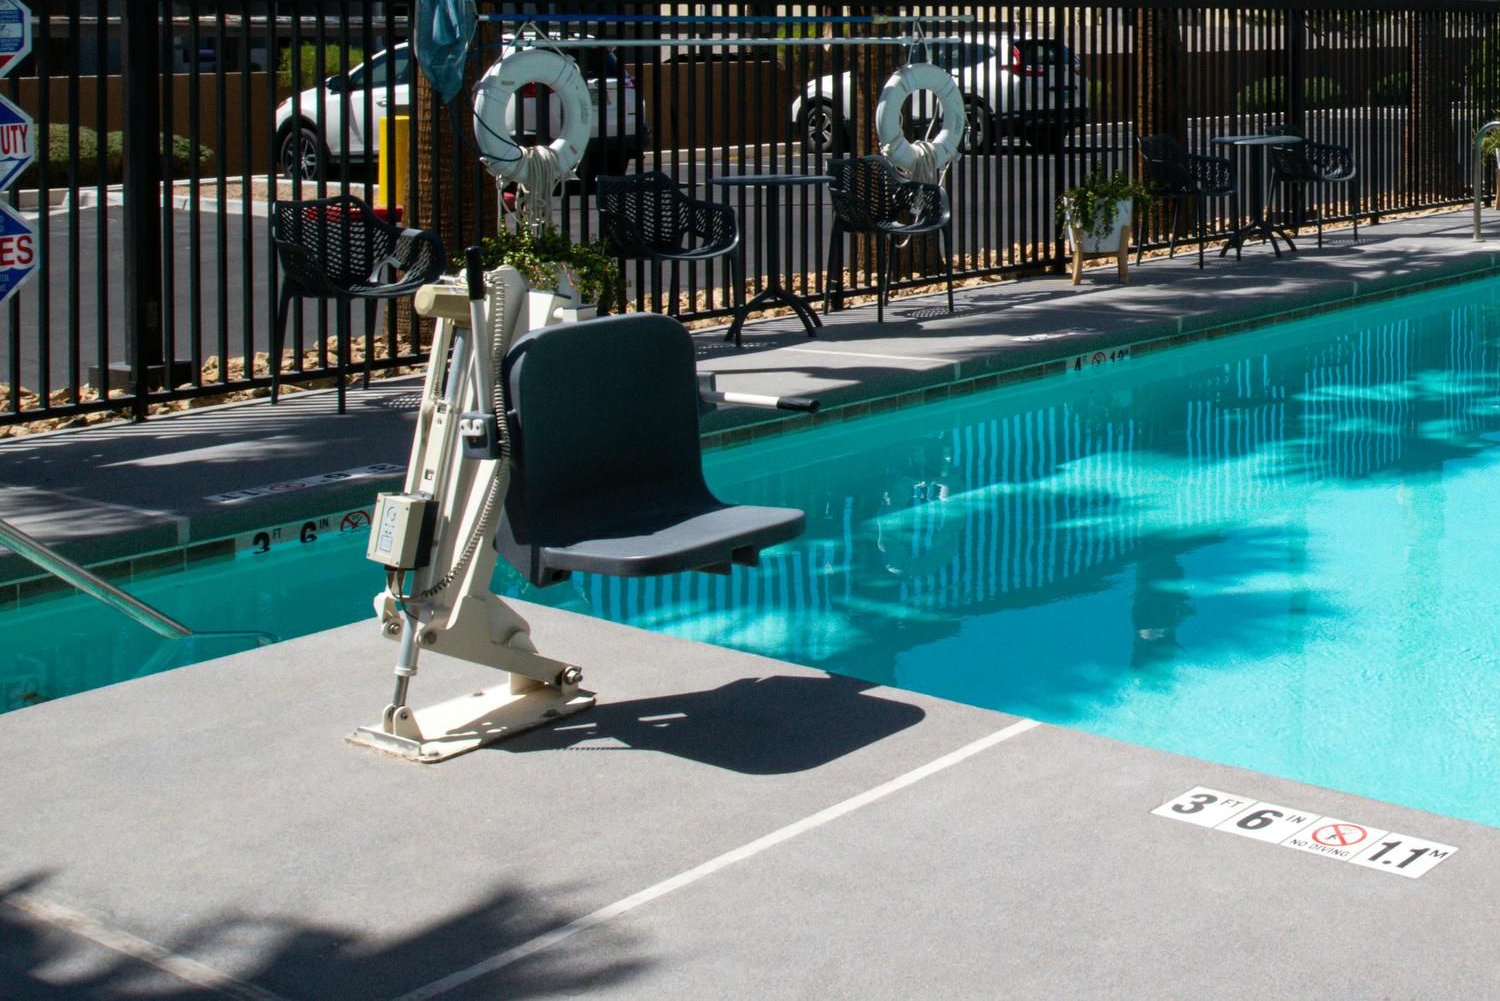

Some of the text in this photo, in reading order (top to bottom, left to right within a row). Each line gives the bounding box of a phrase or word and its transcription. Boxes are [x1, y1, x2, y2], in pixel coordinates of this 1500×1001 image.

[319, 517, 329, 529] IN
[1172, 794, 1305, 830] 3 FT 6 IN
[1290, 838, 1350, 858] NO DIVING
[1368, 840, 1449, 869] 1.1 M
